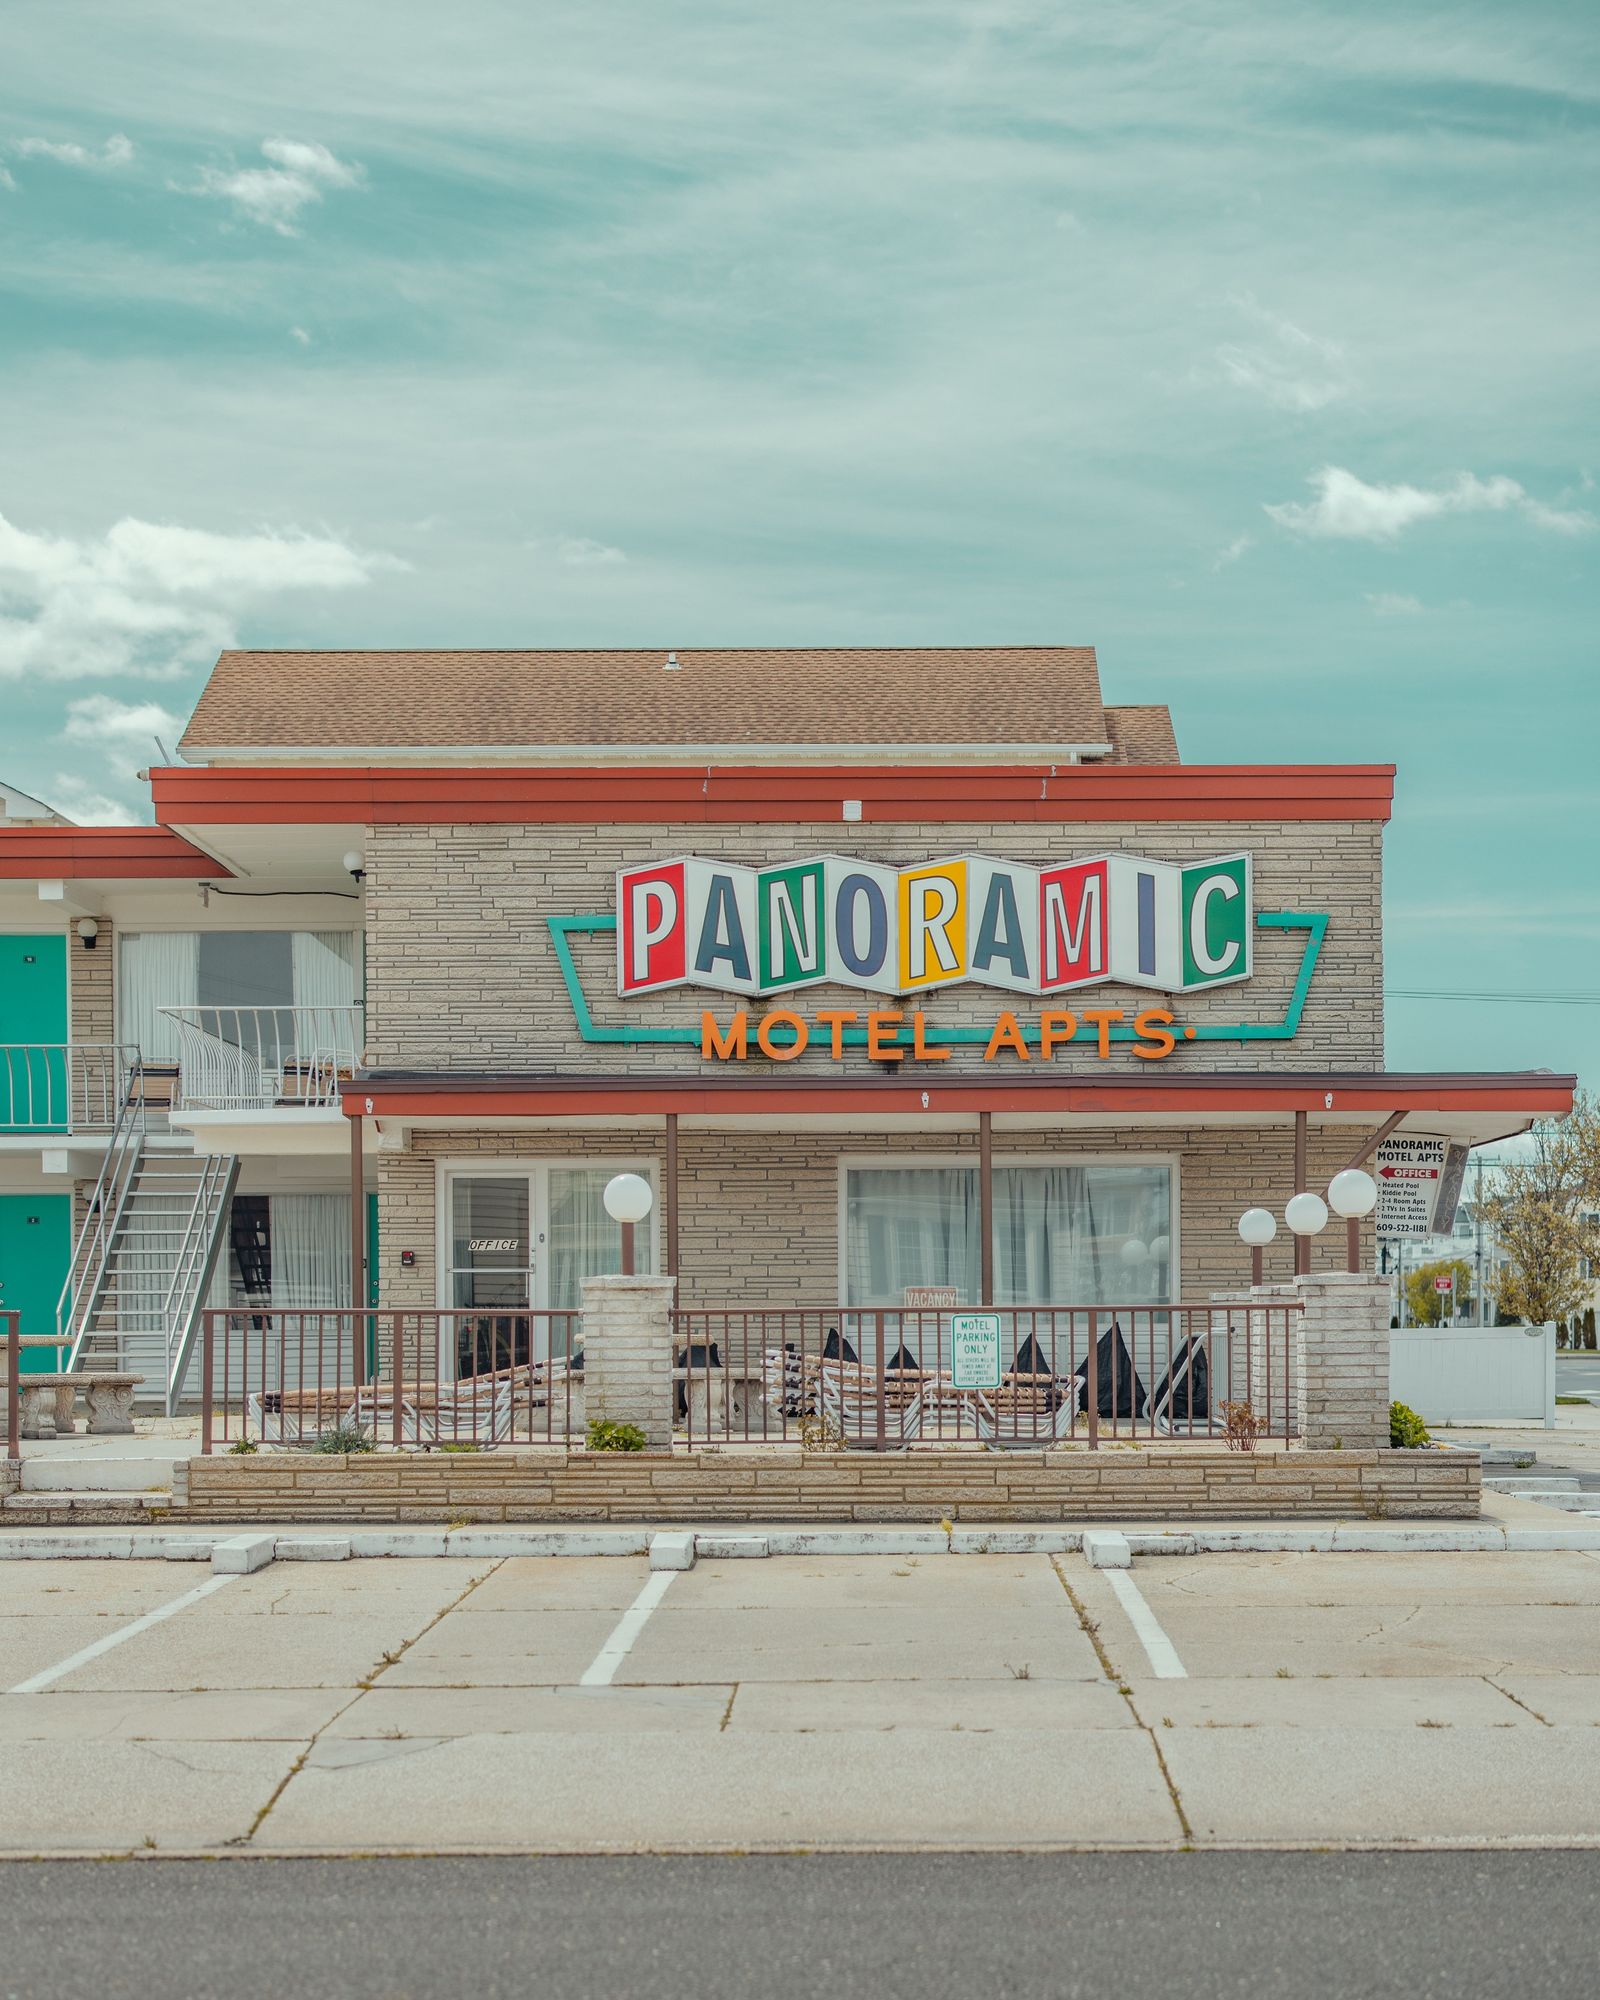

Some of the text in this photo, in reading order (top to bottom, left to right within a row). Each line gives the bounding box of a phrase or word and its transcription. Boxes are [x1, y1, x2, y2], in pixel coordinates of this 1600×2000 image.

[632, 872, 1240, 981] PANORAMIC
[702, 1010, 951, 1060] MOTEL
[1377, 1152, 1444, 1162] MOTEL APTS
[1393, 1169, 1432, 1178] OFFICE
[1376, 1223, 1427, 1233] 609-522-1181
[470, 1240, 517, 1250] OFFICE
[907, 1292, 956, 1307] VACANCY
[961, 1320, 990, 1330] MOTEL
[956, 1332, 996, 1342] PARKING
[964, 1344, 988, 1354] ONLY
